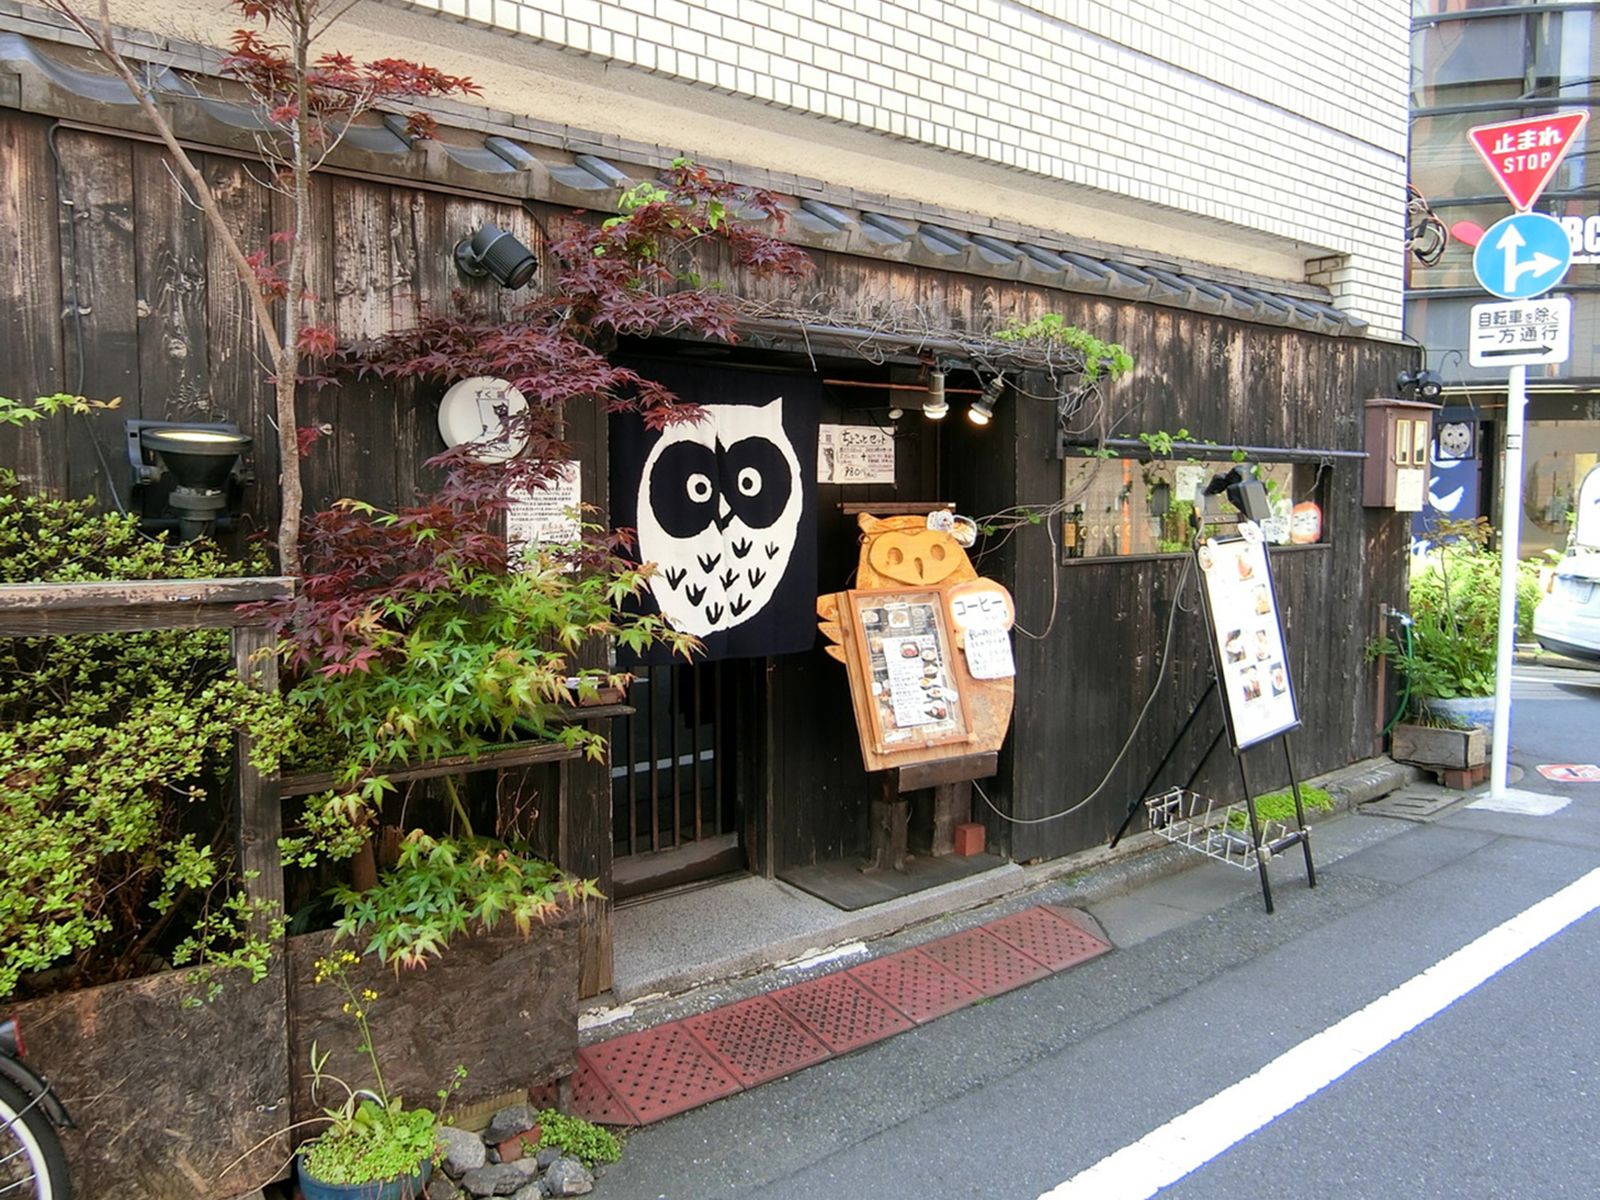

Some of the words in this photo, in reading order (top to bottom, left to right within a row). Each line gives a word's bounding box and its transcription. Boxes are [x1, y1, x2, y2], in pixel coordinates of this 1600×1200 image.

[1491, 126, 1562, 155] 止まれ
[1503, 153, 1551, 173] STOP
[1553, 215, 1600, 253] BC
[1478, 307, 1559, 328] 自転車を除く
[1478, 325, 1559, 344] 一方通行
[953, 595, 1004, 617] コーヒー
